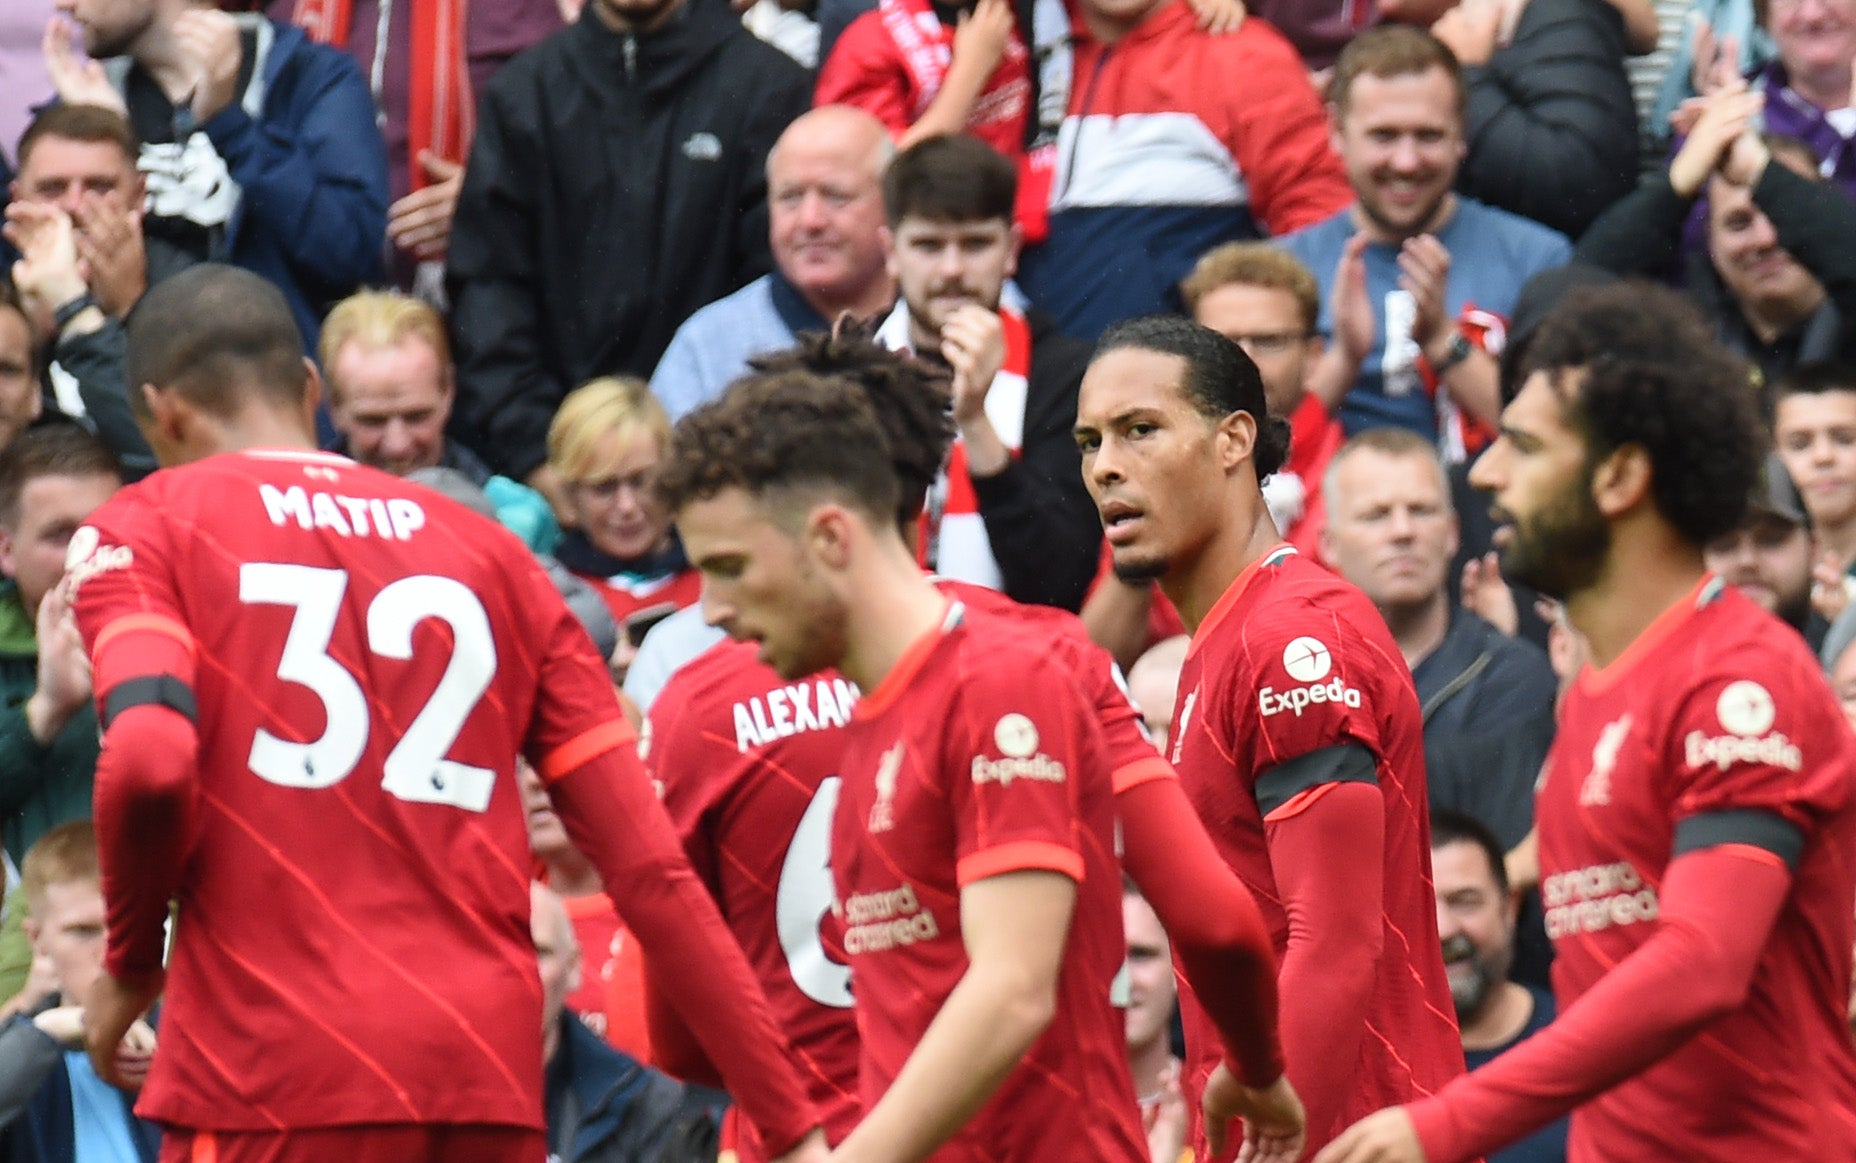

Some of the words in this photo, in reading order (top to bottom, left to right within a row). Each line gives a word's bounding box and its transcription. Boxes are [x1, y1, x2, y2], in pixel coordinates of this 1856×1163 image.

[258, 484, 425, 541] MATIP
[239, 562, 497, 812] 32
[1259, 676, 1361, 717] Expeda
